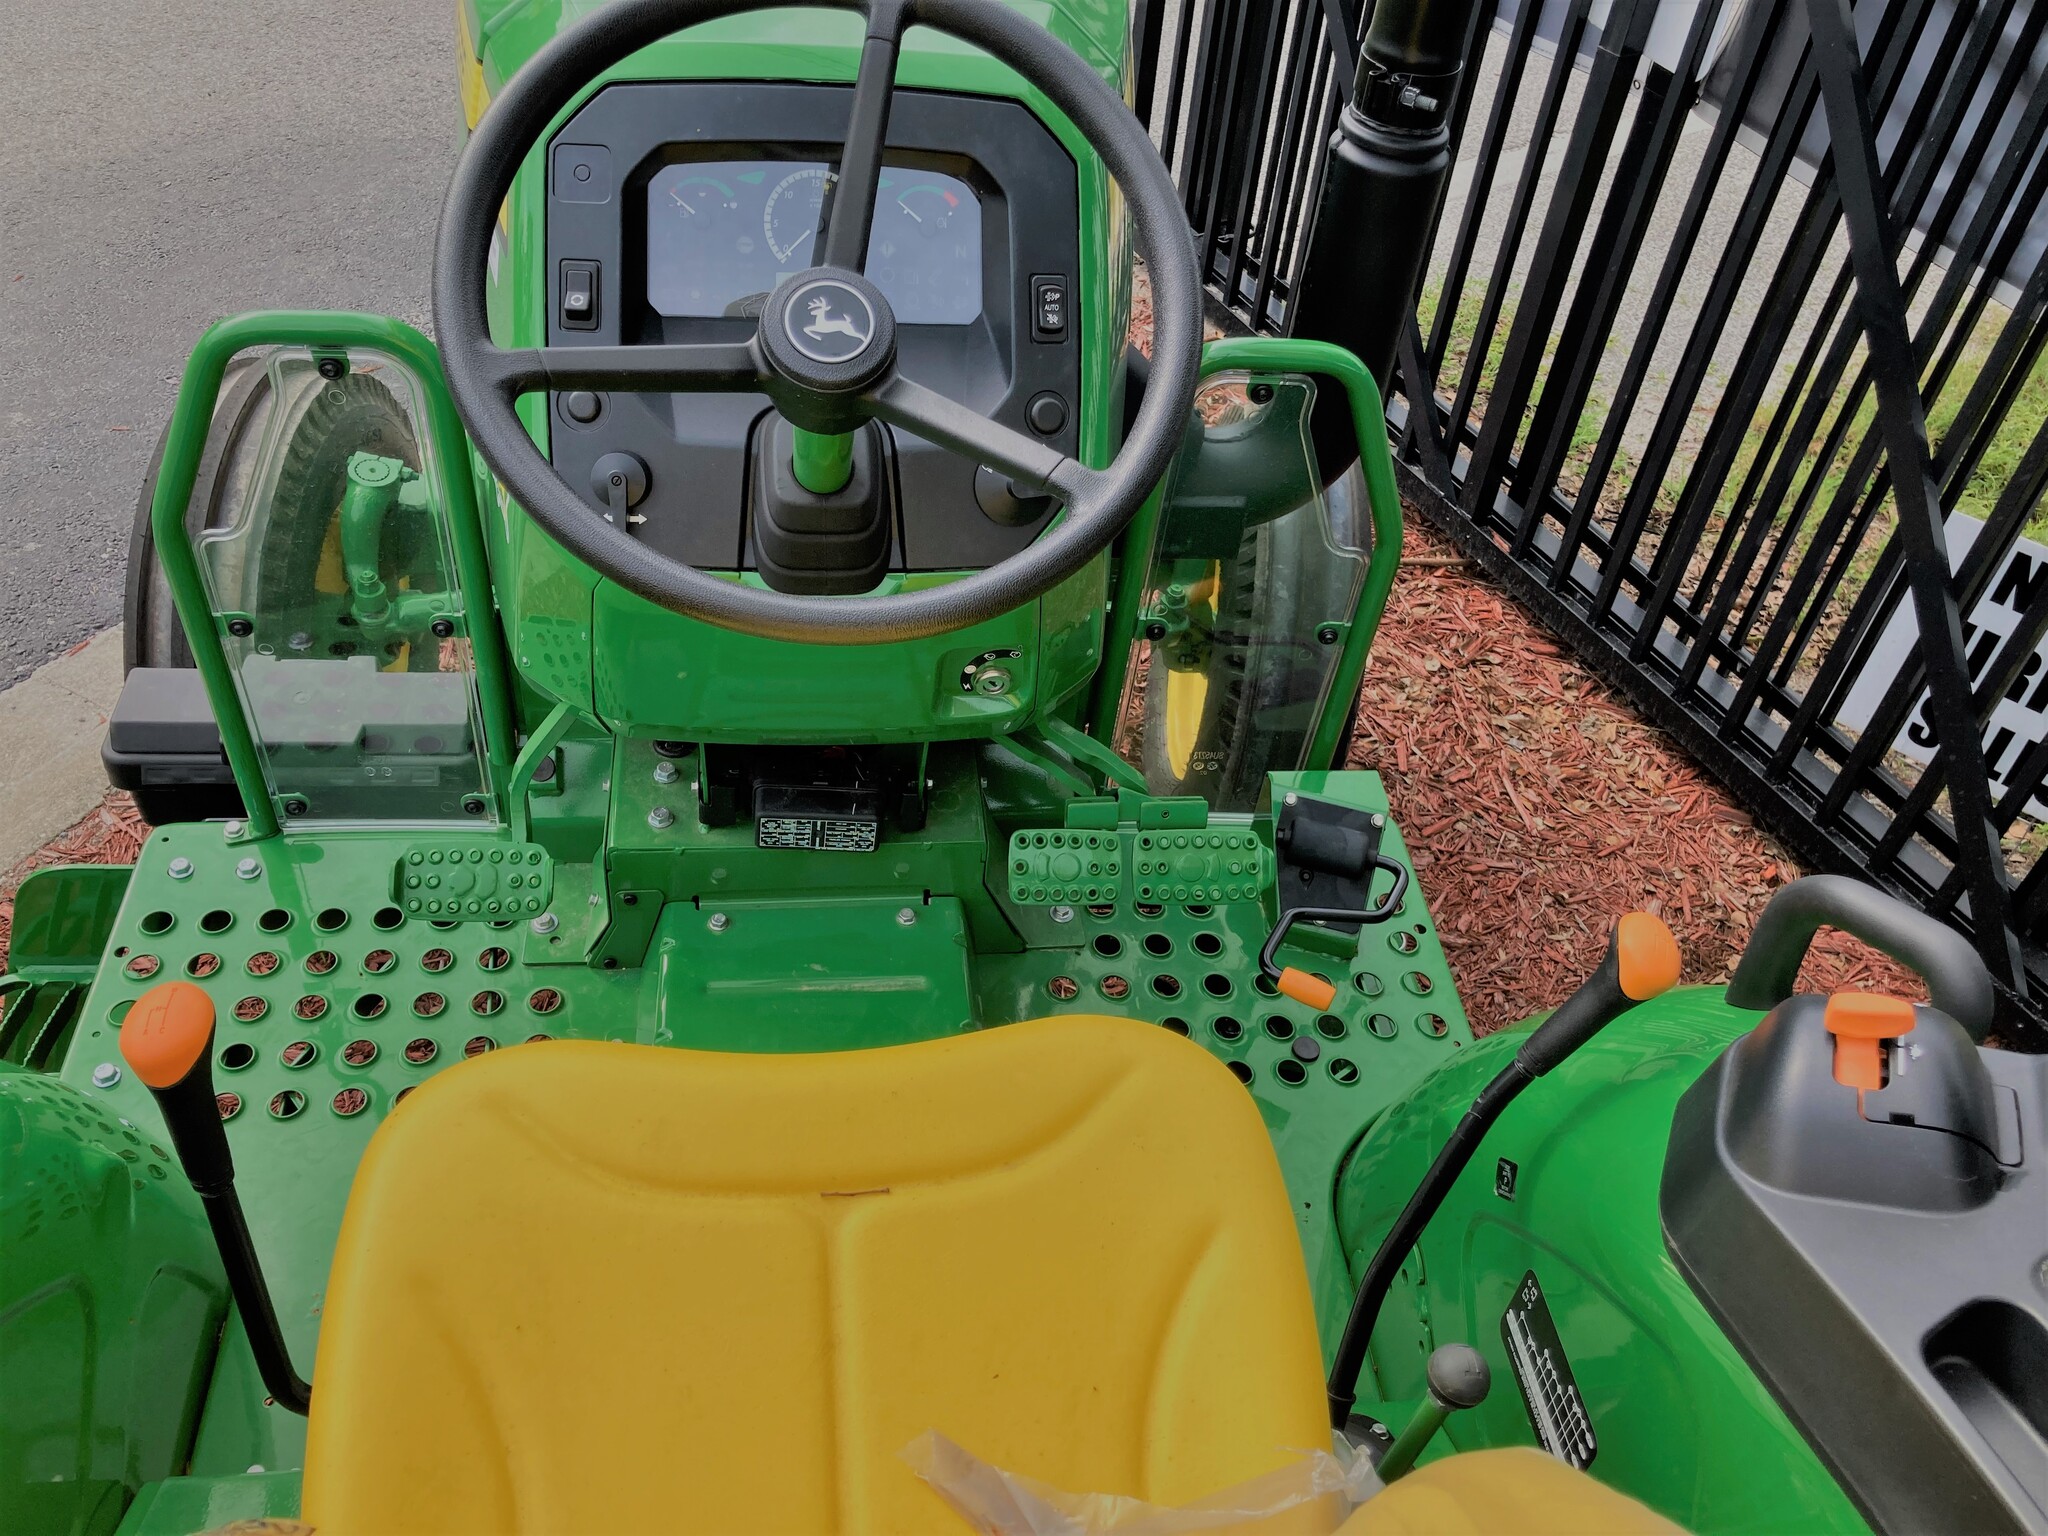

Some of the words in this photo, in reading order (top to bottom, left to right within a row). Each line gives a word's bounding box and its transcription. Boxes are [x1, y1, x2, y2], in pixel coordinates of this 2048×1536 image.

[811, 178, 821, 187] 15
[784, 191, 793, 199] 10
[773, 219, 779, 227] 5
[1044, 303, 1060, 311] AUTO
